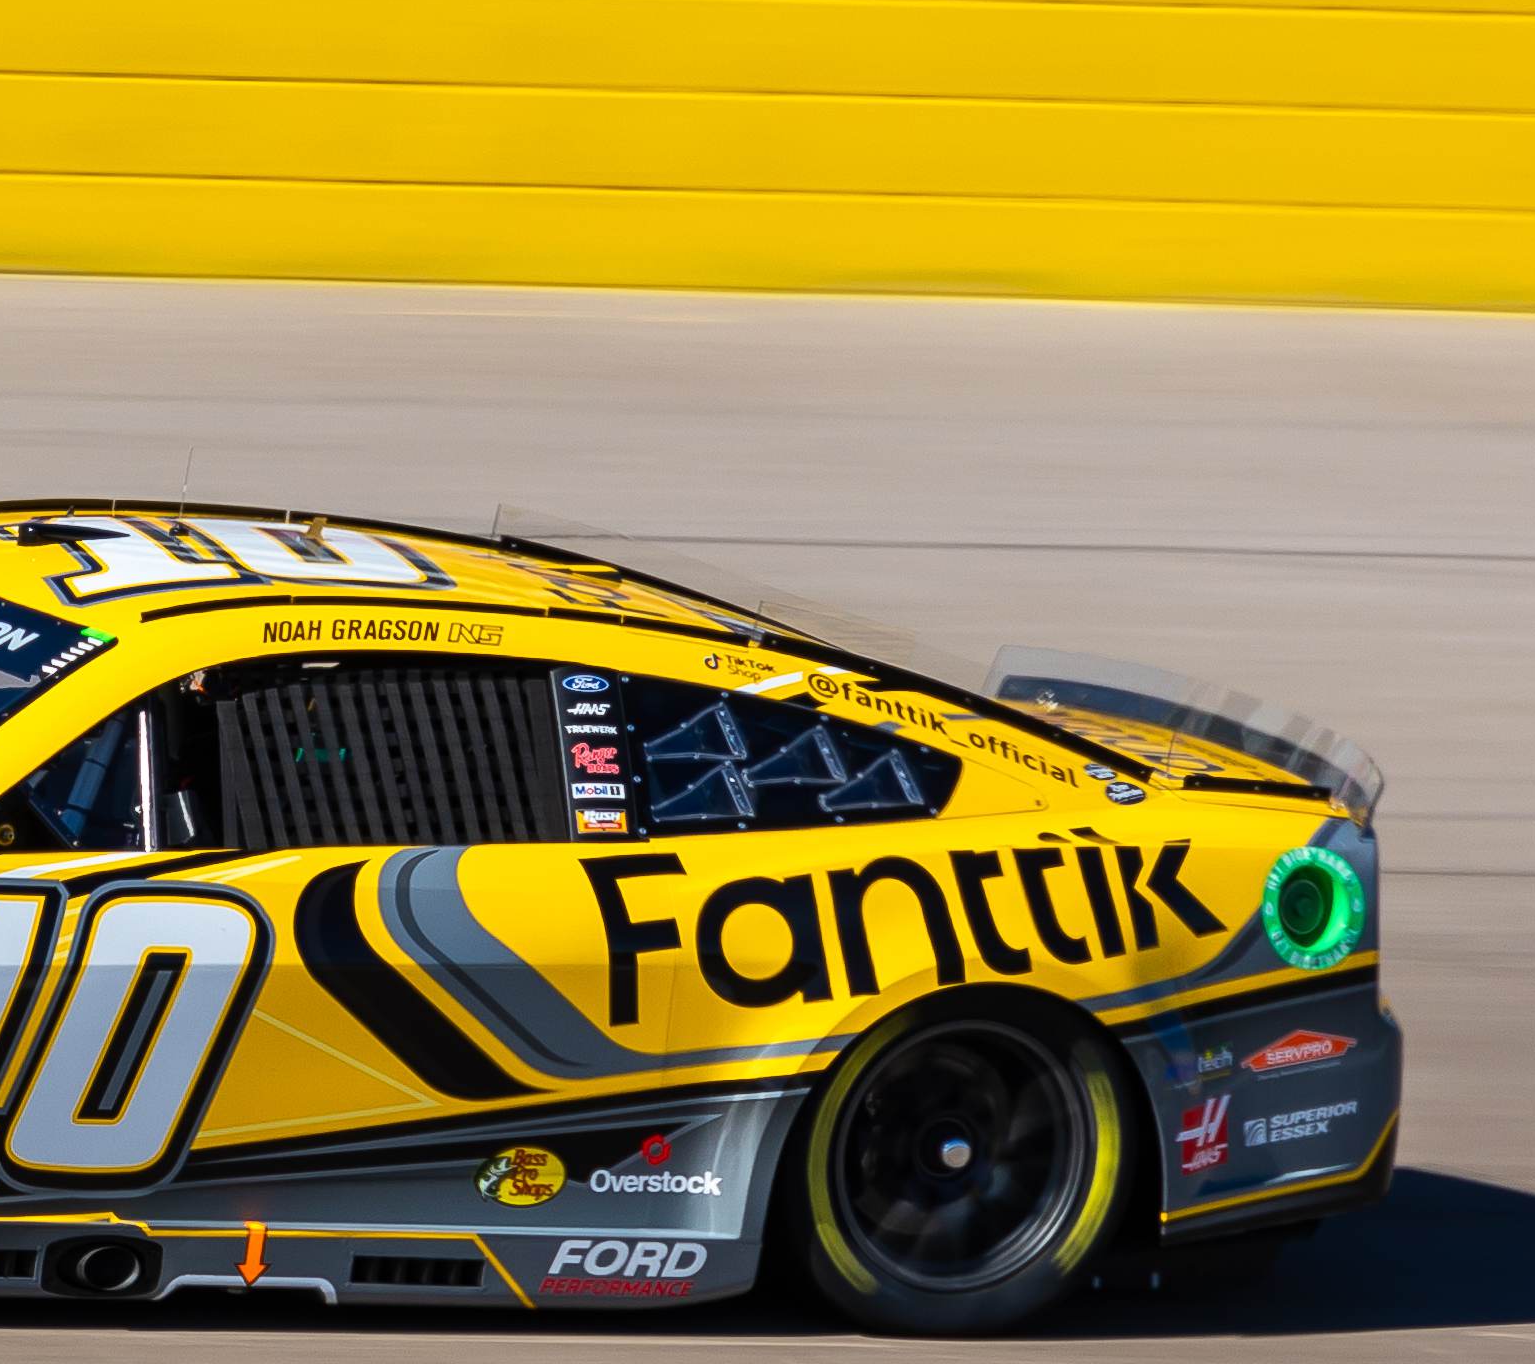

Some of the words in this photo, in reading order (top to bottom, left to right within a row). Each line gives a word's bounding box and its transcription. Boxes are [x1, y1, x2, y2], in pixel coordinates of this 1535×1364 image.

[263, 620, 322, 643] NOAH
[332, 619, 439, 642] GRAGSON
[724, 654, 776, 673] TikTok
[727, 664, 762, 684] Shop
[807, 673, 1079, 788] @fanttik_official
[575, 785, 608, 796] Mobil
[576, 826, 1229, 1028] Fanttik
[1265, 1040, 1333, 1065] SERVPRO
[1269, 1101, 1358, 1128] SUPERIOR
[1269, 1120, 1330, 1142] ESSEX
[510, 1148, 549, 1167] Bass
[511, 1165, 539, 1181] Pro
[589, 1169, 723, 1196] Overstock
[508, 1180, 555, 1201] Shops
[547, 1240, 708, 1278] FORD
[537, 1277, 695, 1298] PERFORMANCE
